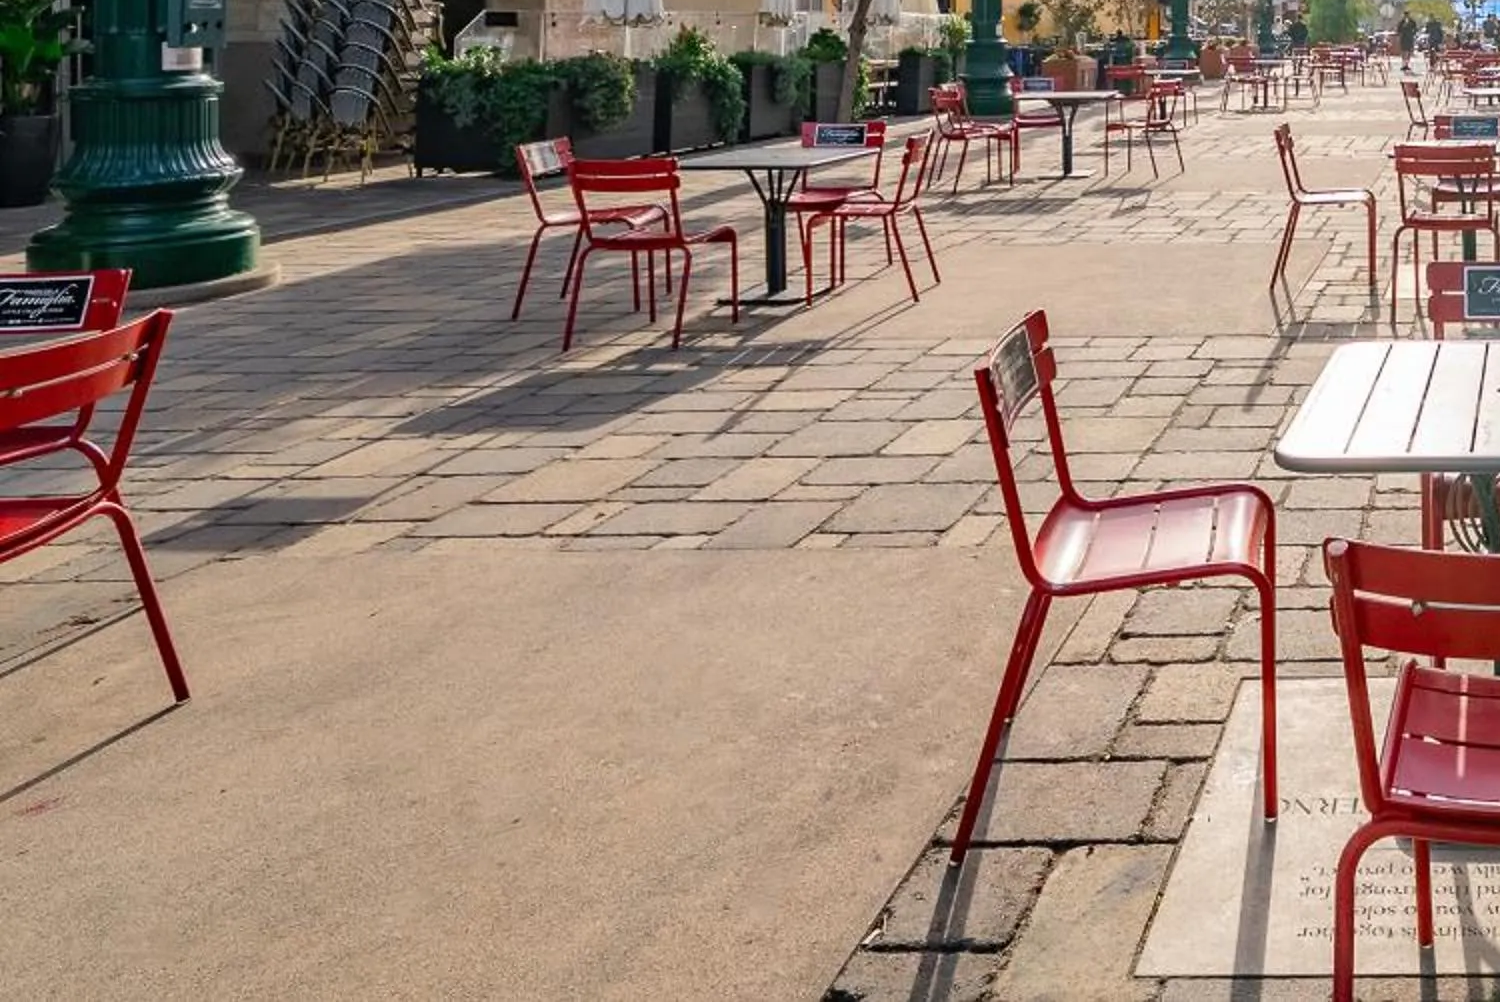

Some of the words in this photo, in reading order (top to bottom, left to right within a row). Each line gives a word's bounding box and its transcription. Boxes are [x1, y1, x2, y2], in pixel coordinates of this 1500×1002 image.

[1432, 865, 1464, 877] we
[1299, 884, 1332, 900] for
[1297, 924, 1394, 942] togher
